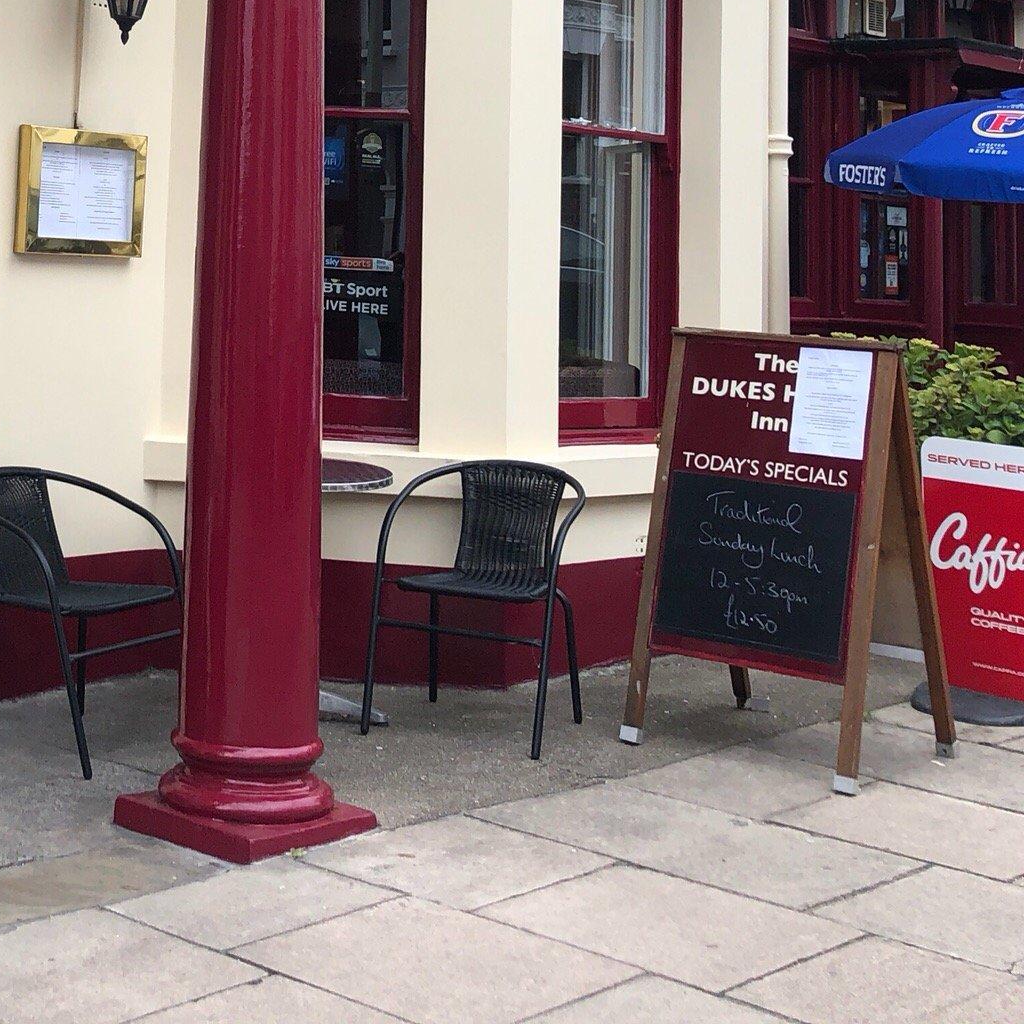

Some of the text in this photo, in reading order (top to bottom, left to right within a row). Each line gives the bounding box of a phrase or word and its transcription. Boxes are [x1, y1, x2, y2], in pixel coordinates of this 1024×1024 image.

[838, 163, 887, 187] FOSTER'S
[325, 257, 372, 268] sky sports
[346, 282, 388, 298] Sport
[323, 299, 389, 315] IVE HERE
[755, 352, 799, 374] The
[692, 377, 776, 402] DUKES
[750, 411, 788, 433] Inn
[682, 451, 849, 487] TODAY'S SPECIALS
[927, 453, 991, 470] SERVED
